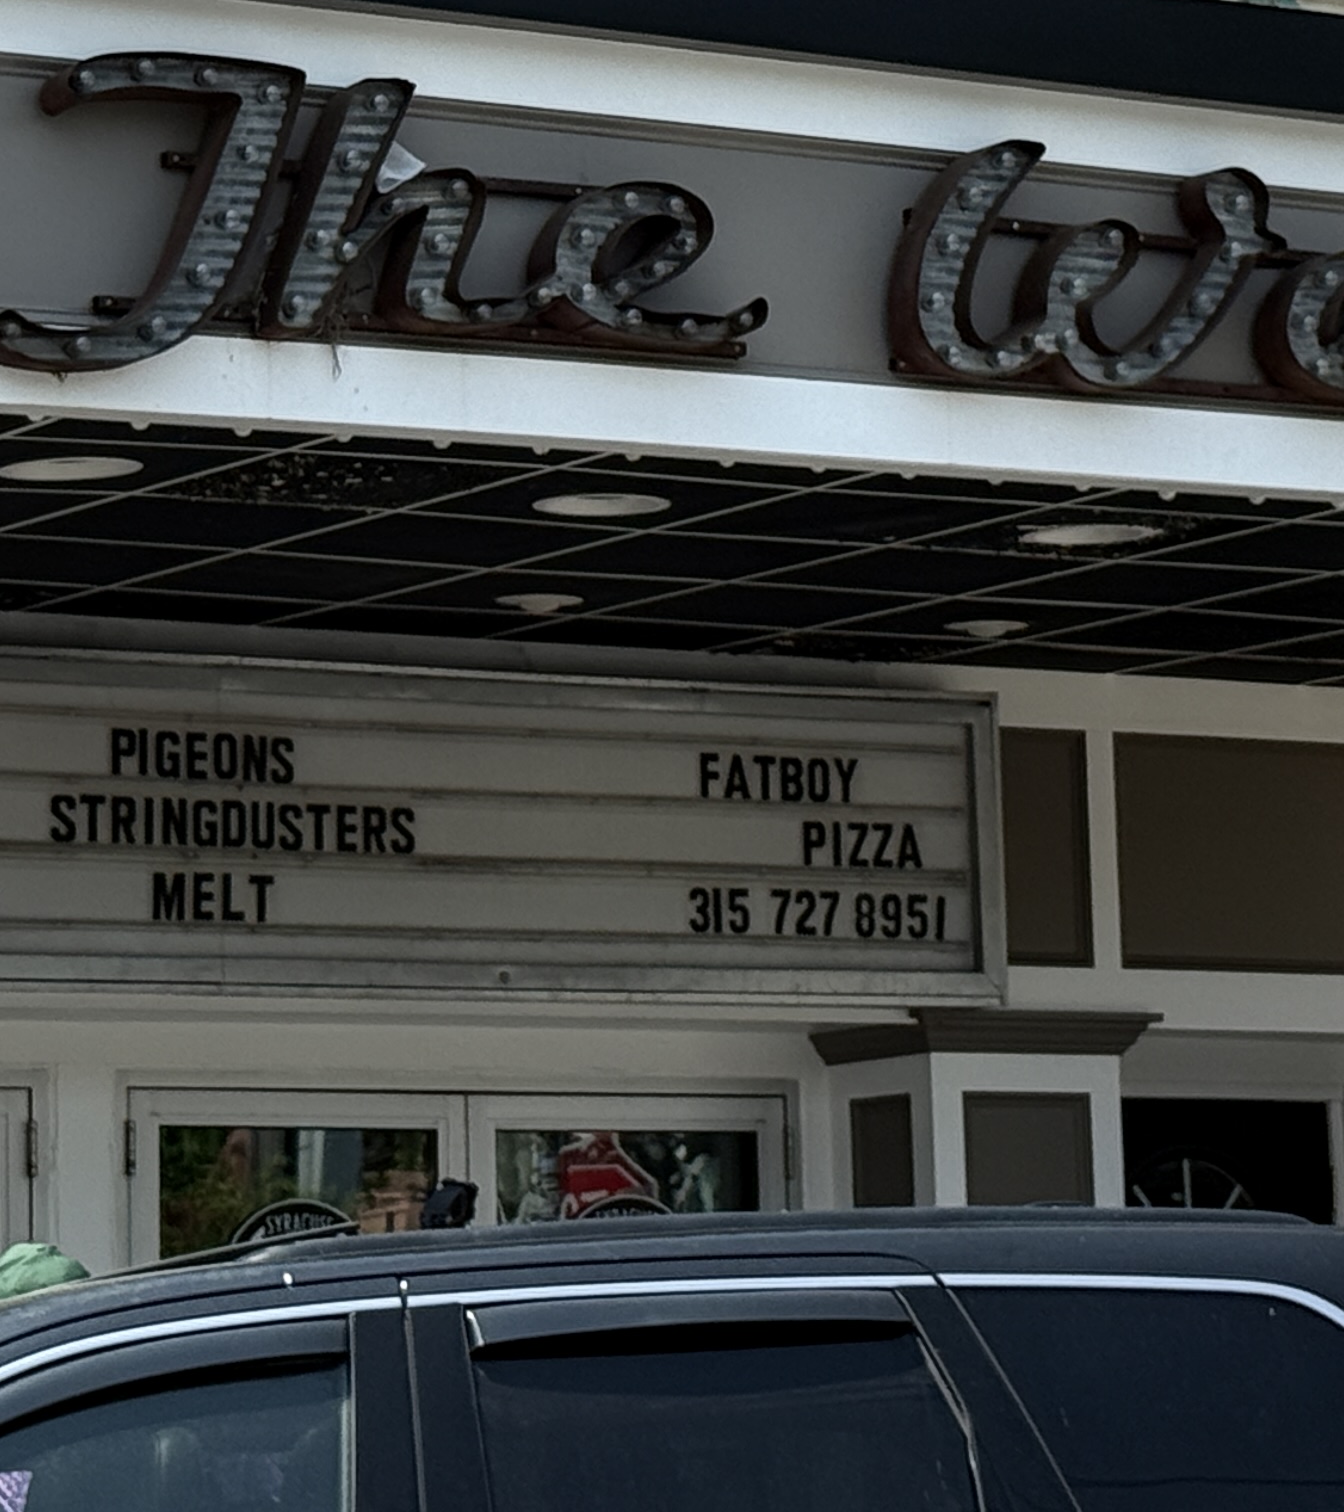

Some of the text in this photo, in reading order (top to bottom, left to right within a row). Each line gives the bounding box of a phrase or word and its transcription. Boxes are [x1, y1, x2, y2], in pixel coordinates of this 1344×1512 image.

[110, 727, 295, 784] PIGEONS
[699, 752, 858, 804] FATBOY
[50, 793, 416, 855] STRINGDUSTERS
[802, 820, 923, 869] PIZZA
[152, 871, 275, 923] MELT
[689, 887, 946, 941] 315 727 8951
